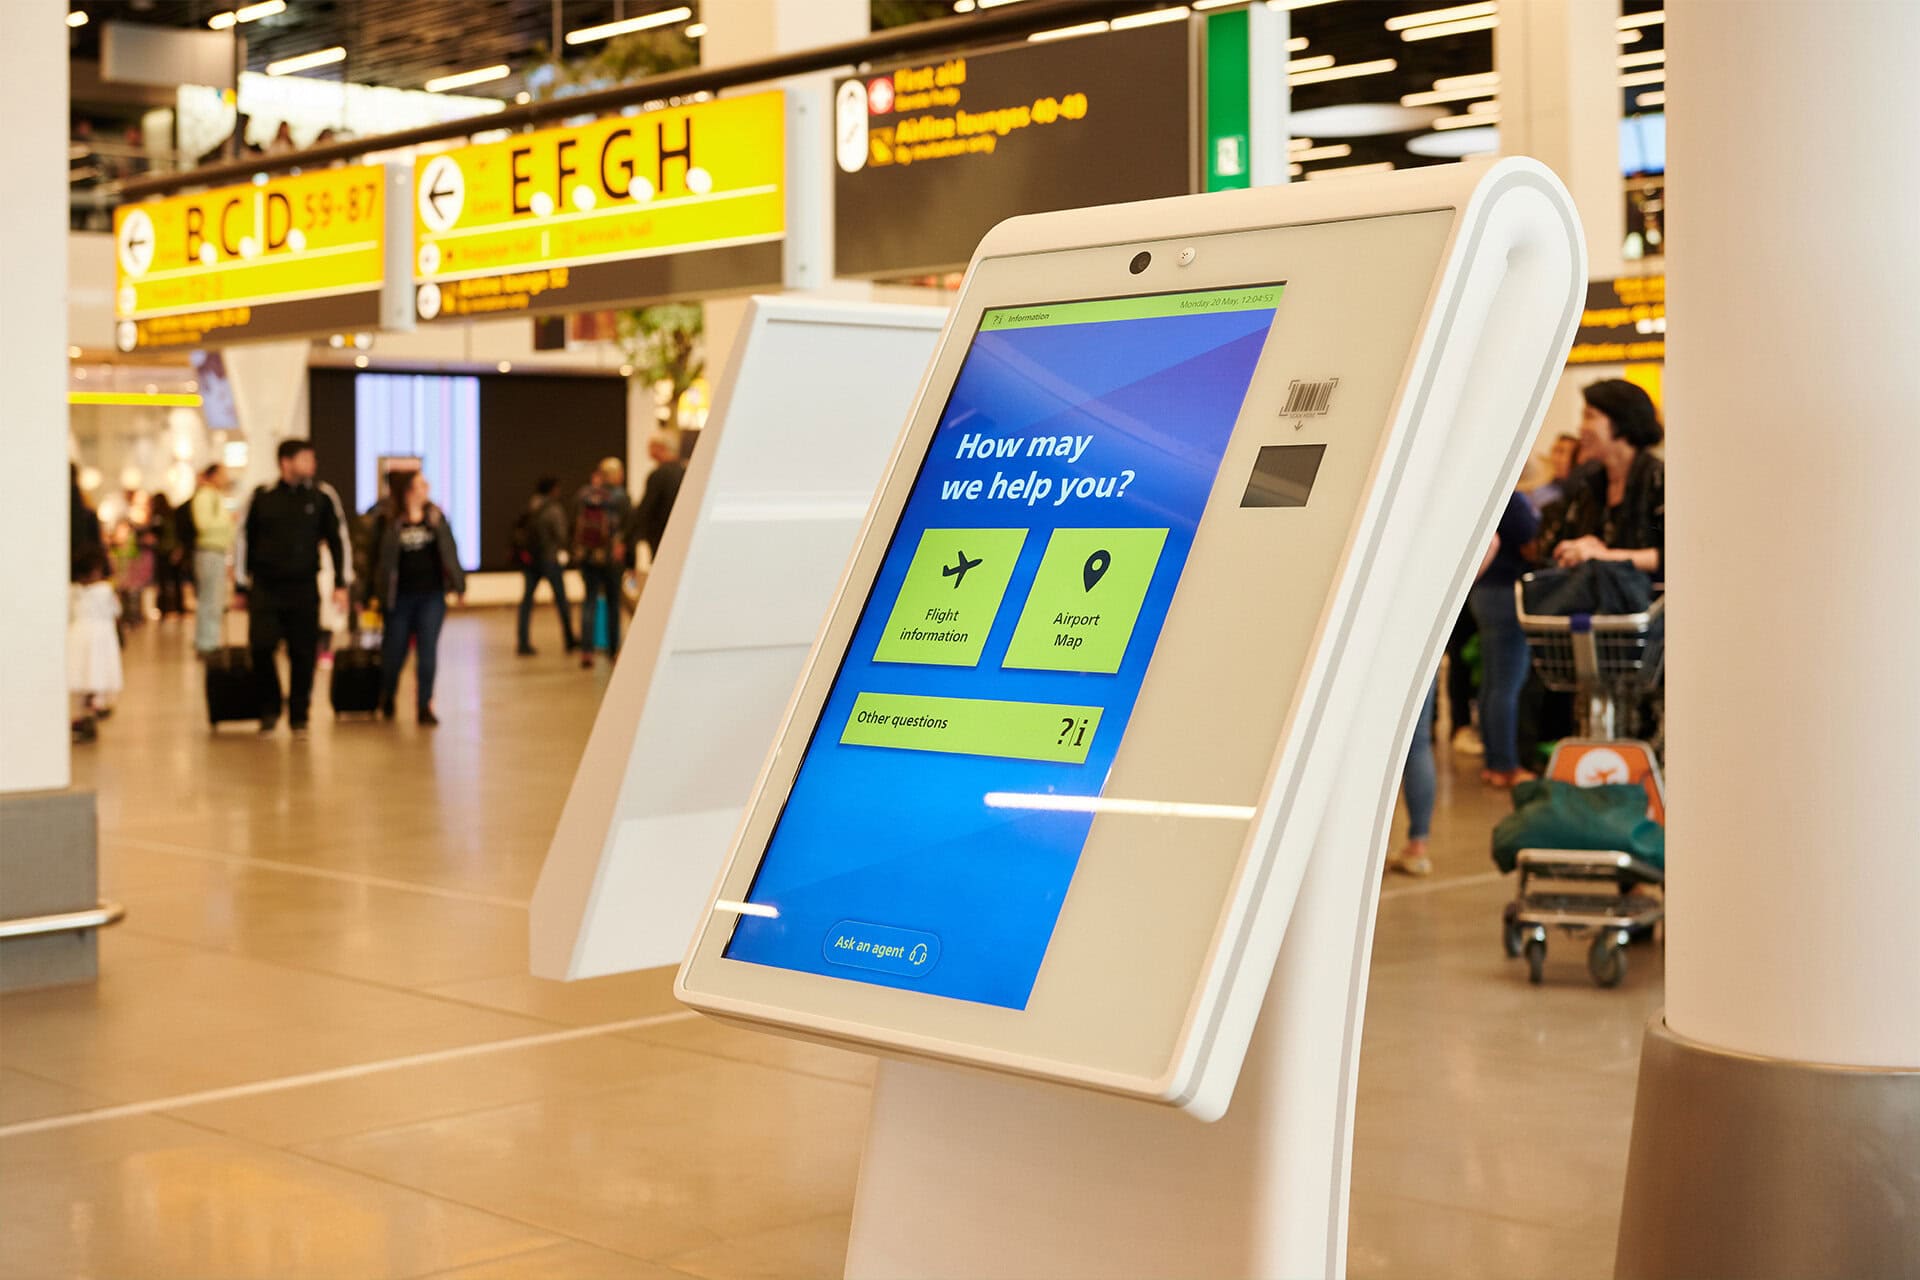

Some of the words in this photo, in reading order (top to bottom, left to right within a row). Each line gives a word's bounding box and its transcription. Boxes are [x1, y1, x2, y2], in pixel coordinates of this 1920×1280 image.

[511, 147, 532, 215] E
[557, 139, 577, 208] F
[600, 128, 635, 199] G
[657, 117, 692, 193] H
[187, 206, 206, 262] B
[221, 199, 241, 256] C
[267, 192, 292, 249] D
[1180, 299, 1209, 309] Monday
[1008, 313, 1050, 323] Information
[955, 433, 1024, 460] How
[1026, 434, 1094, 464] may
[940, 478, 983, 500] we
[987, 470, 1053, 506] help
[1053, 469, 1136, 506] you?
[925, 608, 960, 624] Flight
[1053, 612, 1100, 628] Airport
[899, 628, 969, 643] information
[1053, 634, 1083, 650] Map
[857, 710, 891, 724] Other
[891, 714, 949, 729] questions
[834, 935, 856, 950] Ask
[856, 941, 871, 953] an
[871, 943, 905, 958] agent
